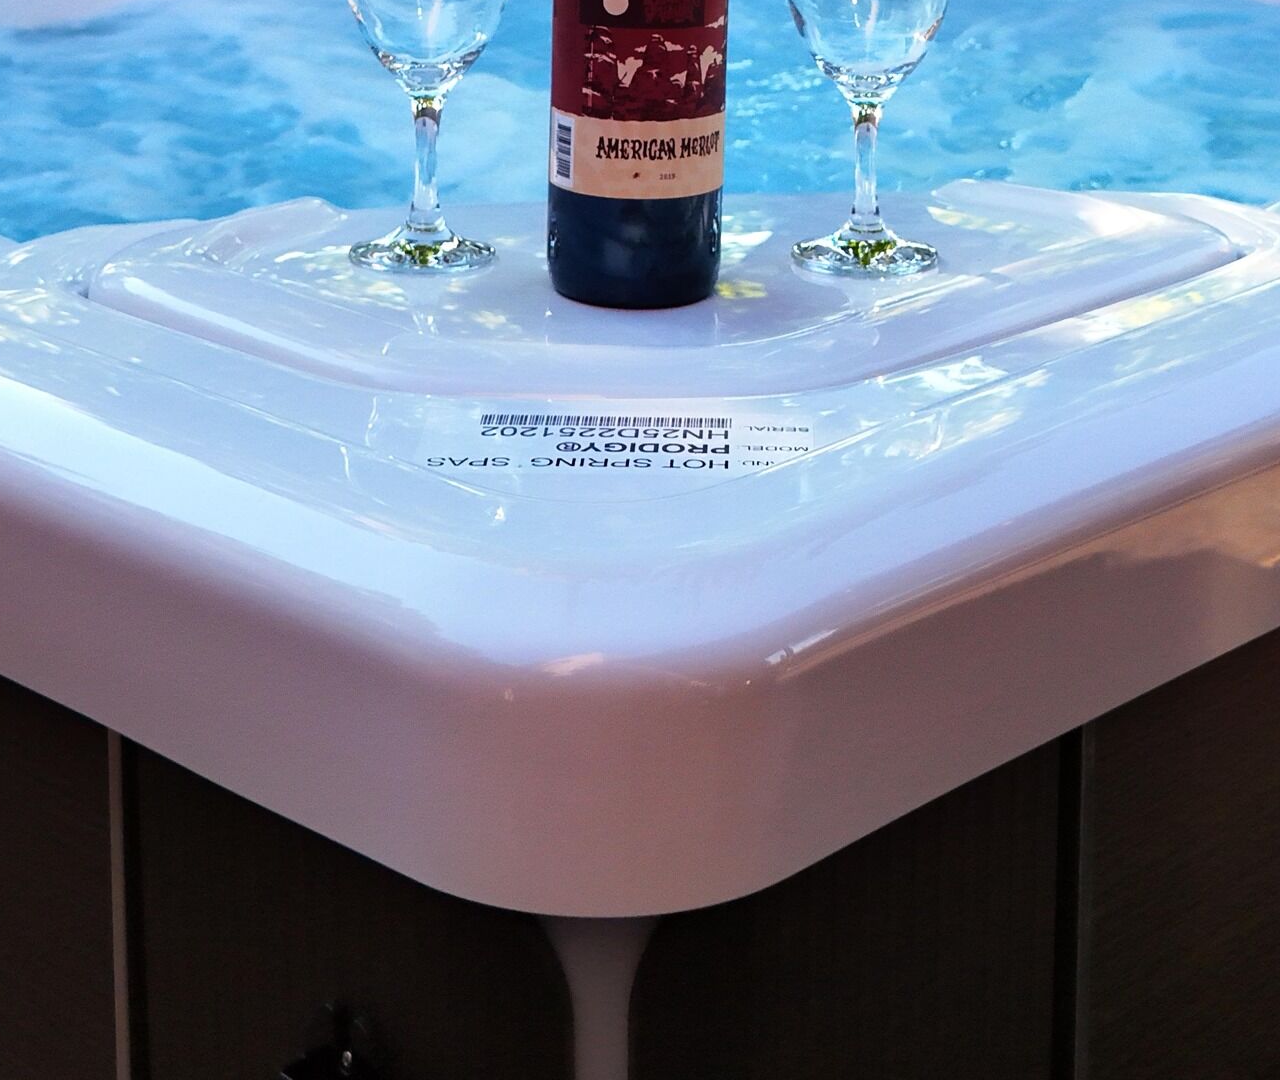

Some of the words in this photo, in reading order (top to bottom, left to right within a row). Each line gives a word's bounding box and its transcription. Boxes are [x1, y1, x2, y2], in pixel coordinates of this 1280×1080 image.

[596, 136, 677, 161] AMERICAN
[680, 130, 720, 159] MERLOT
[480, 426, 729, 440] HN25D2251202
[426, 456, 511, 468] SPAS
[530, 456, 653, 469] SPRING
[662, 458, 729, 469] HOT
